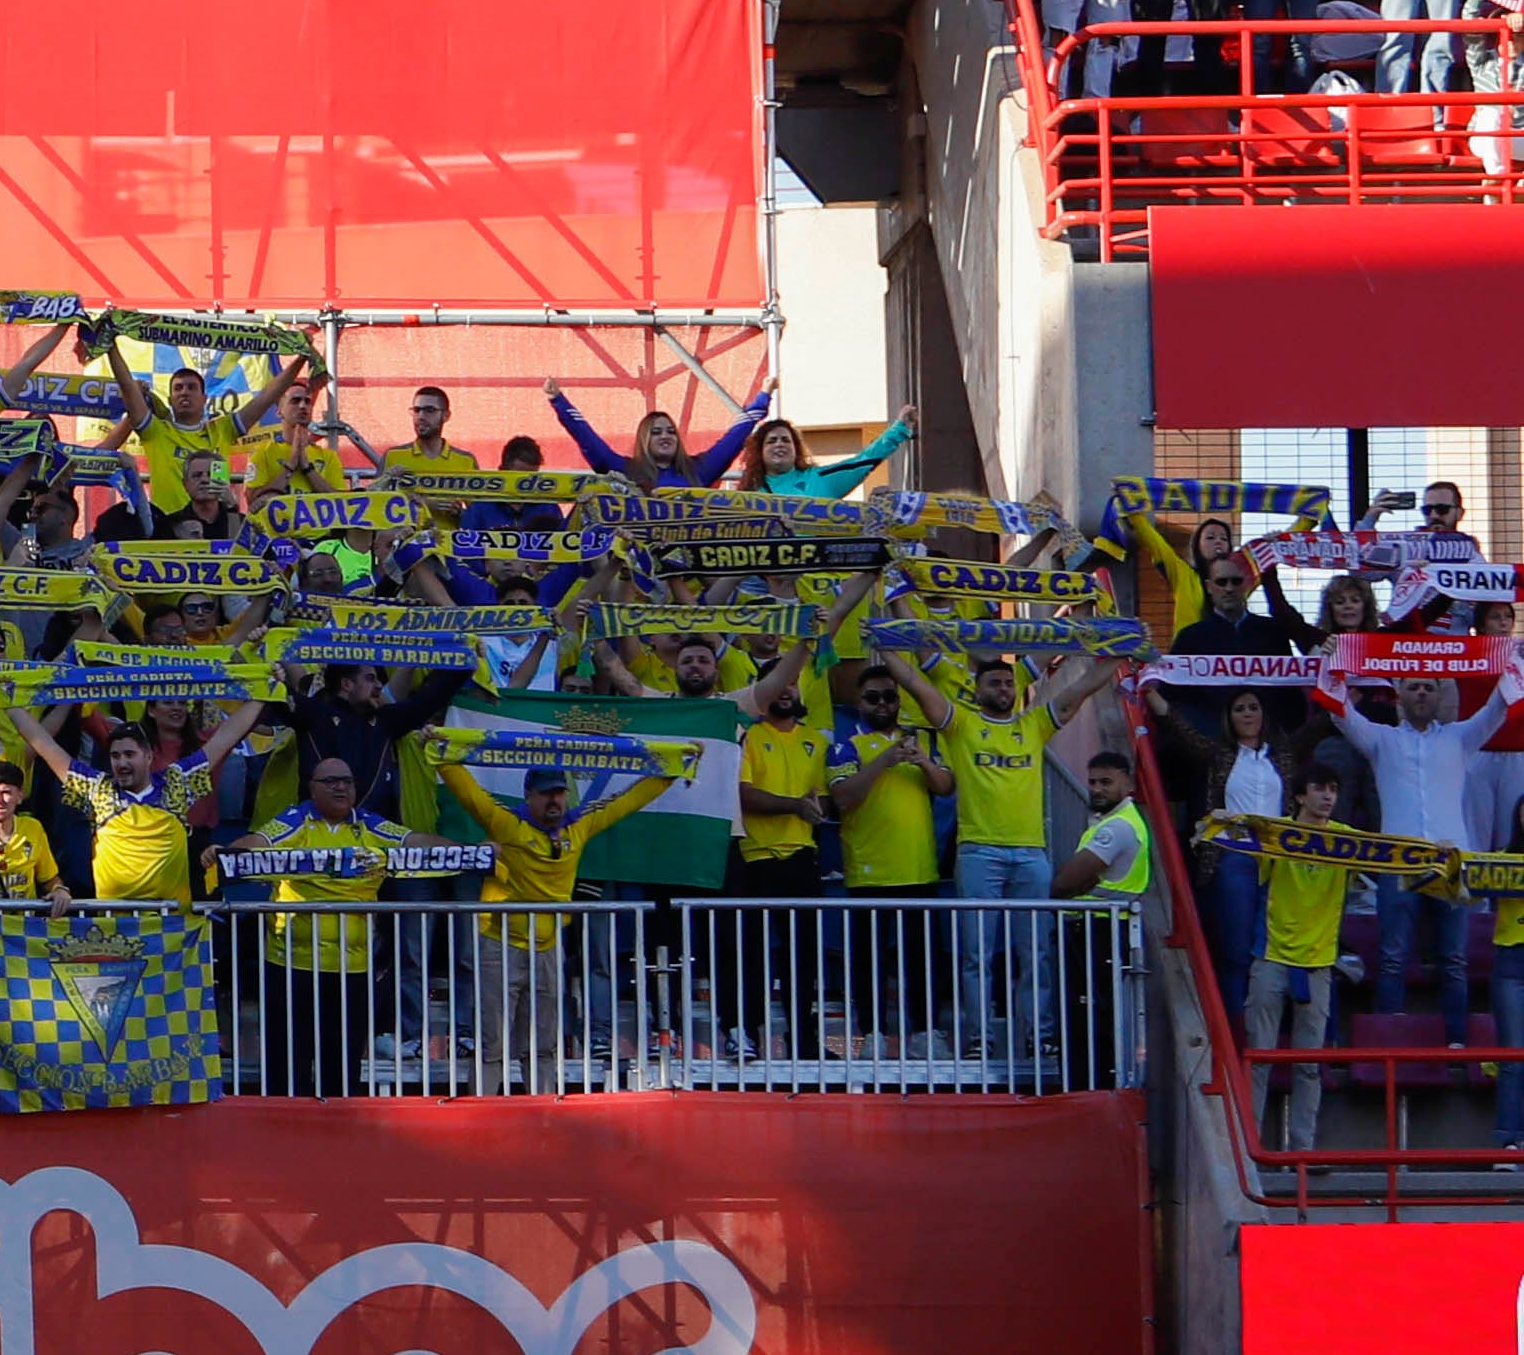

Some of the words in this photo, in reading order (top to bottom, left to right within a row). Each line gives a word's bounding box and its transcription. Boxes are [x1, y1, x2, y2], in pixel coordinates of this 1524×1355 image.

[138, 324, 214, 346] SUBMARINO
[400, 472, 502, 493] Somos
[516, 472, 557, 493] de
[114, 555, 220, 584] CADIZ
[931, 563, 1045, 598] CADIZ
[347, 612, 389, 630] LOS
[396, 607, 535, 629] ADMIRABLES
[299, 646, 379, 664] SECCION
[385, 647, 468, 666] BARBATE
[86, 670, 123, 684] PEÑA
[128, 671, 192, 684] CADISTA
[53, 684, 138, 701] SECCION
[144, 682, 228, 698] BARBATE
[516, 736, 553, 751] PEÑA
[557, 736, 616, 751] CADISTA
[481, 748, 557, 768] SECCION
[563, 750, 643, 771] BARBATE
[974, 752, 1033, 768] DIGI
[1279, 827, 1391, 861] CADIZ
